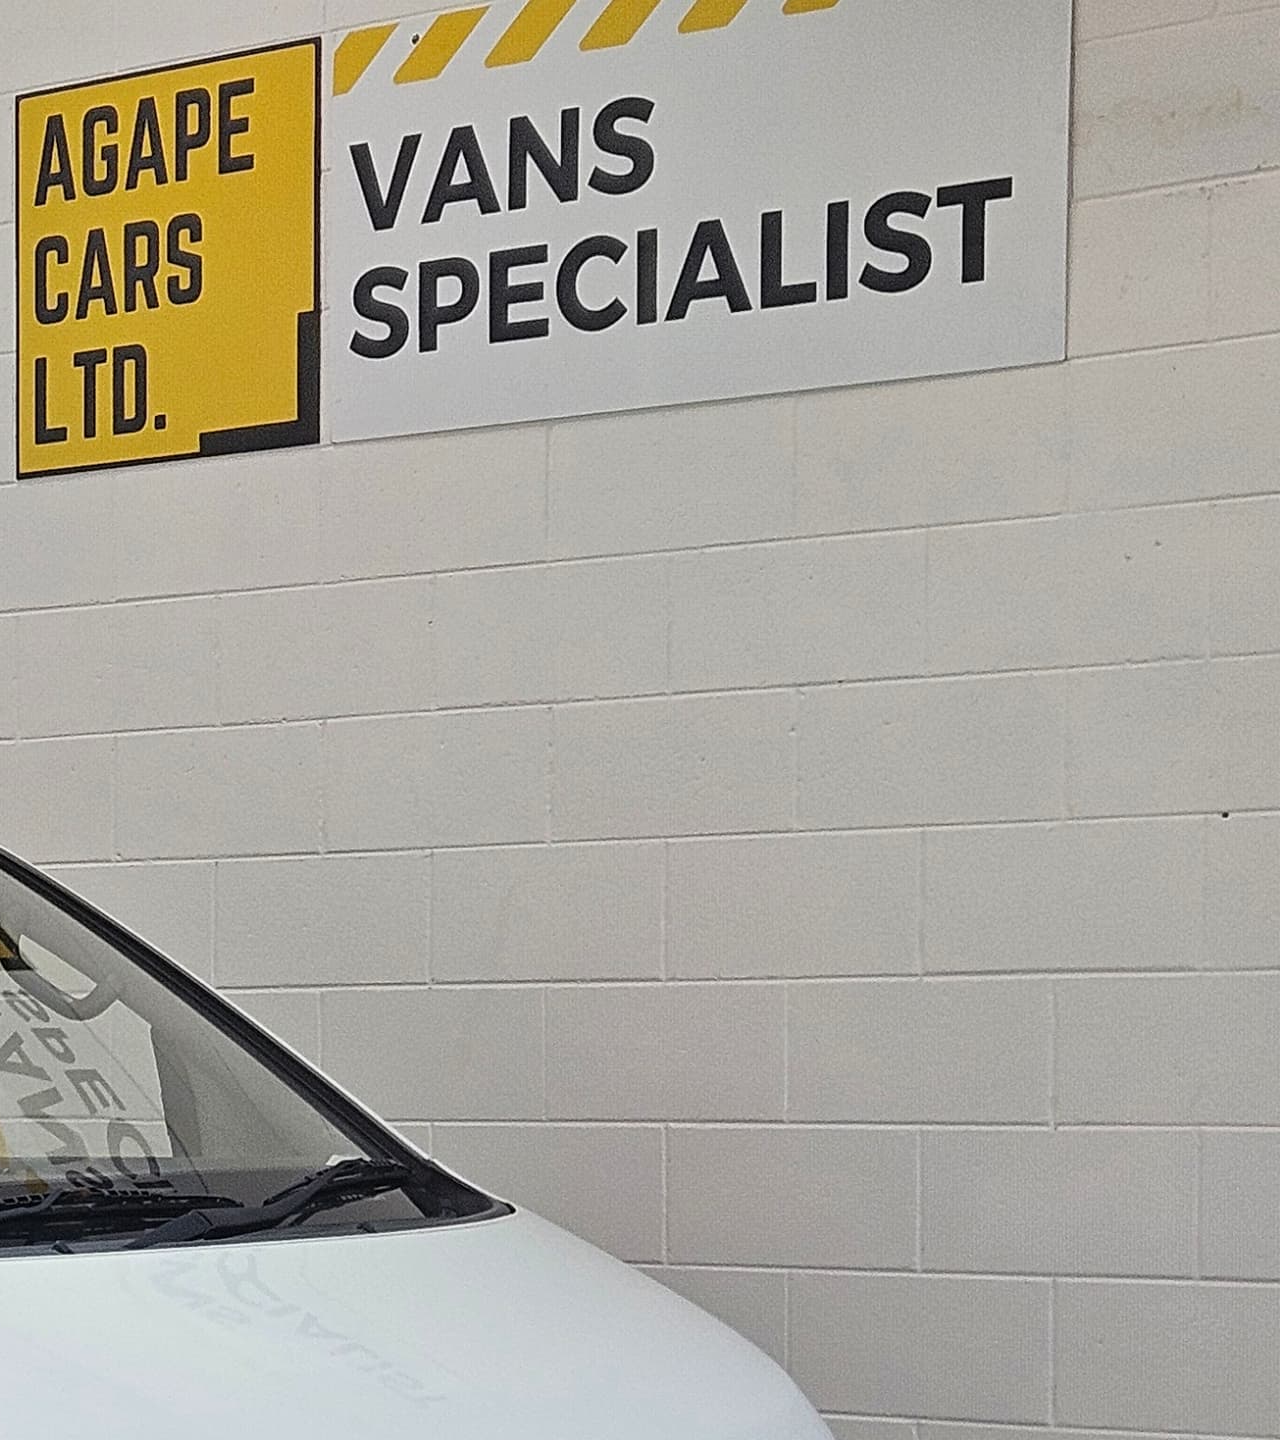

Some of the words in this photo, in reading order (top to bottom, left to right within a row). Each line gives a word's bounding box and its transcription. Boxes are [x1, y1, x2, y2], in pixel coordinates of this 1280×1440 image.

[33, 77, 256, 208] AGAPE
[349, 96, 656, 232] VANS
[33, 213, 204, 326] CARS
[349, 176, 1014, 360] SPECIALIST
[33, 343, 168, 447] LTD.
